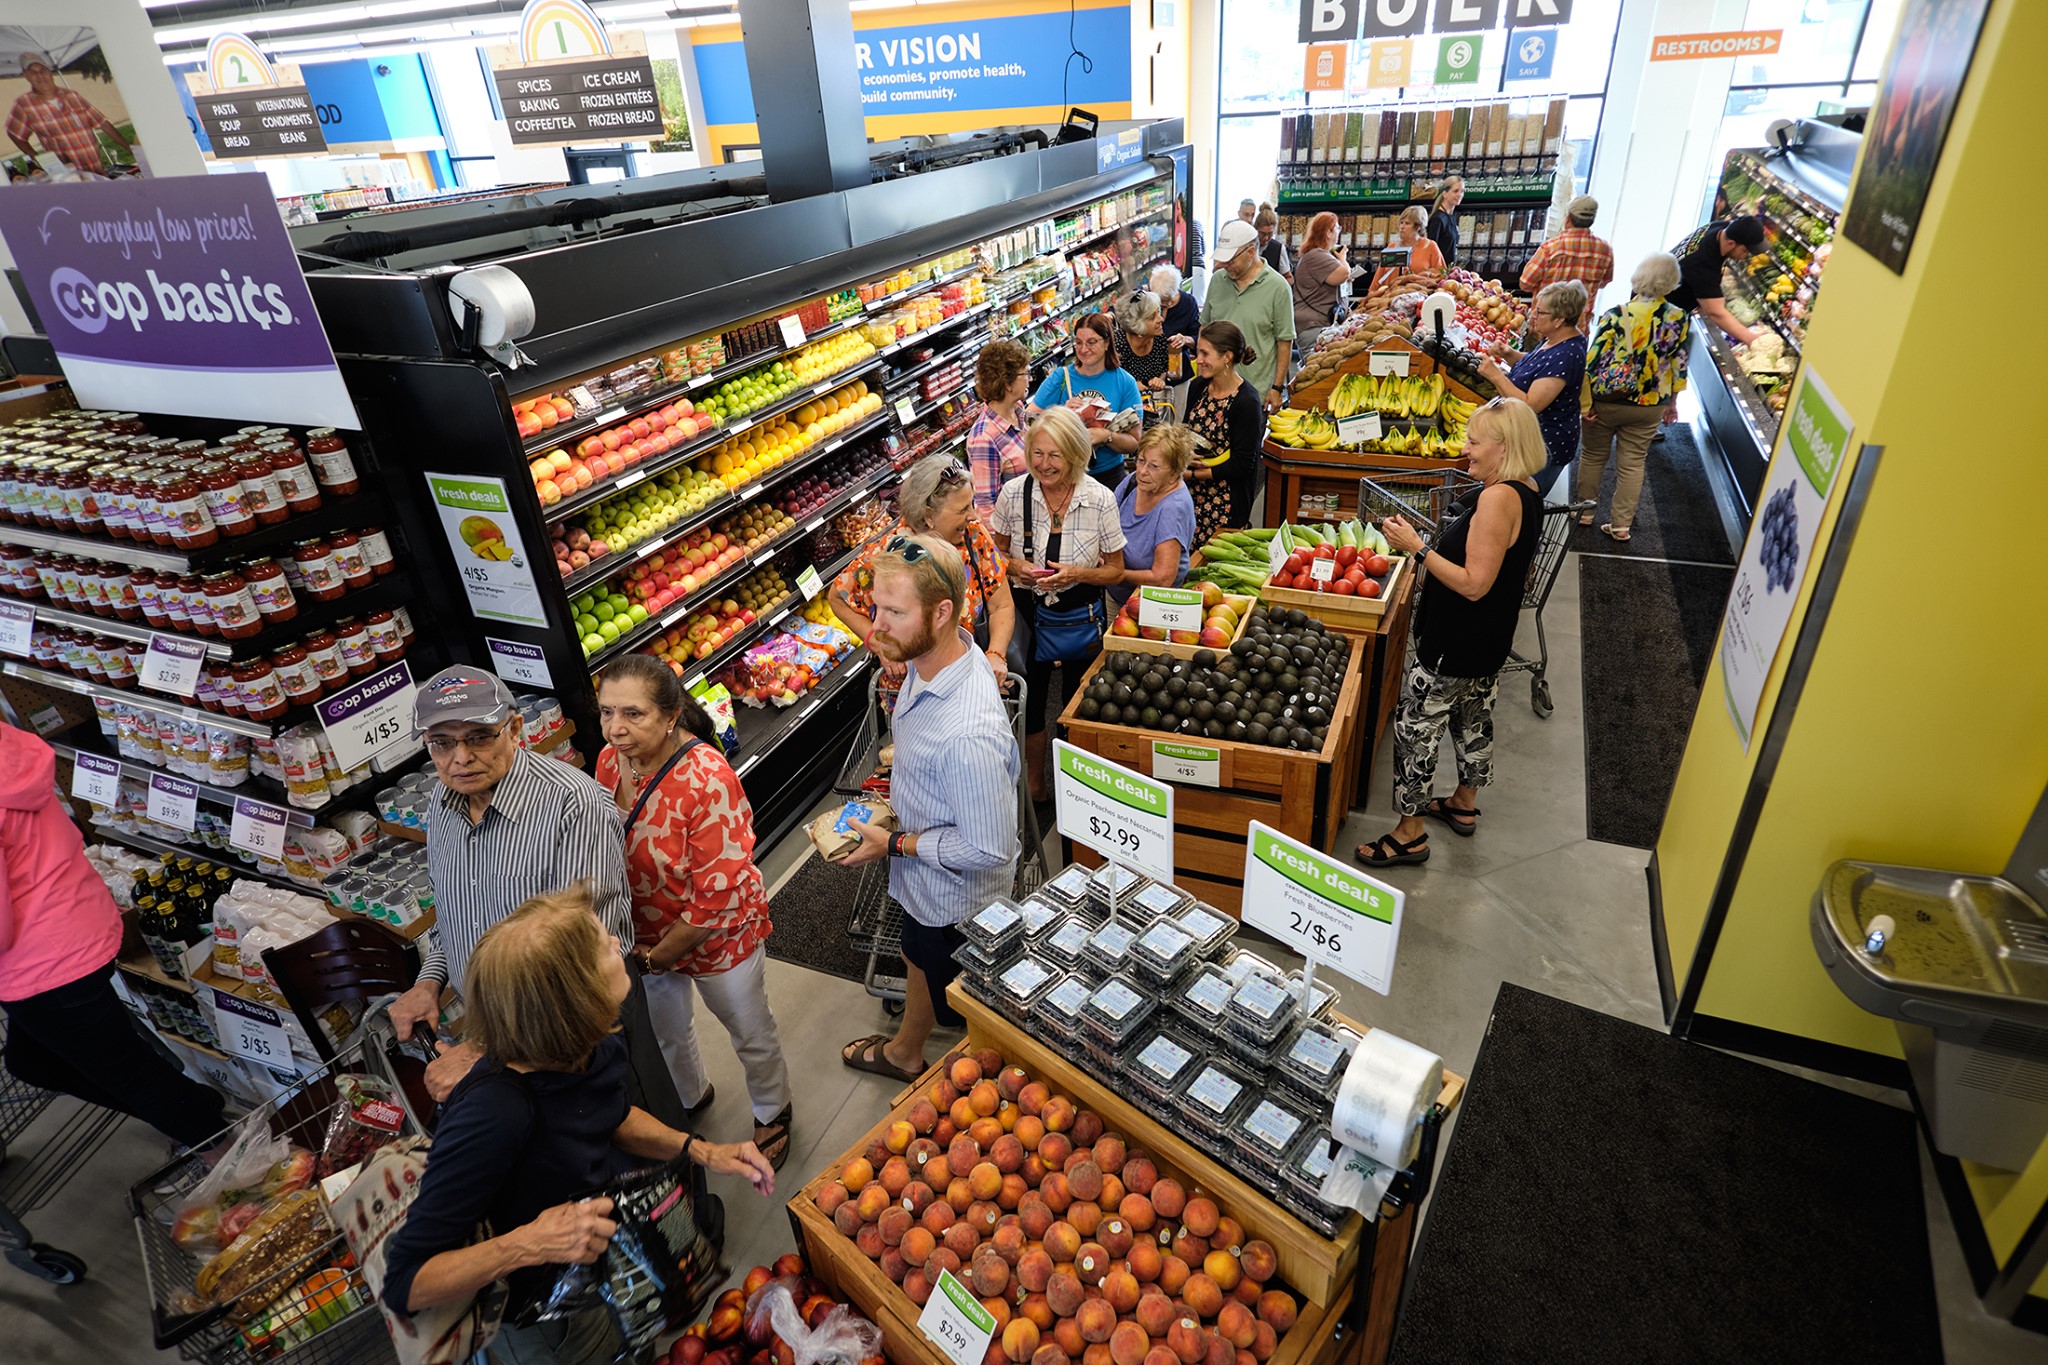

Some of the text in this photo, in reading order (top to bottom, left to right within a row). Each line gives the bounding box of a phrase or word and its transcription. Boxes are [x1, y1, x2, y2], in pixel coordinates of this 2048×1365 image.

[554, 21, 568, 54] 1
[878, 32, 982, 68] VISION
[1656, 37, 1761, 56] RESTROOMS
[230, 56, 249, 84] 2
[864, 62, 1026, 86] economies, promote health,
[1448, 71, 1464, 81] PAY
[1518, 67, 1539, 76] SAVE
[517, 79, 551, 93] SPICES
[583, 71, 641, 88] ICE CREAM
[1317, 79, 1331, 87] FILL
[581, 88, 653, 109] FROZEN ENTRÉES
[860, 86, 957, 103] build community.
[212, 103, 238, 116] PASTA
[256, 97, 308, 112] INTERNATIONAL
[519, 98, 560, 113] BAKING
[220, 119, 241, 132] SOUP
[262, 113, 313, 128] CONDIMENTS
[515, 117, 576, 132] COFFEE/TEA
[588, 109, 655, 128] FROZEN BREAD
[223, 136, 250, 148] BREAD
[279, 131, 307, 144] BEANS
[1497, 184, 1523, 192] reduce
[81, 203, 257, 260] everyday low prices!
[438, 486, 500, 503] fresh deals
[464, 566, 489, 581] 4/$5
[1151, 590, 1193, 601] fresh deals
[1162, 613, 1179, 622] 4/$5
[157, 670, 181, 684] $2.99
[514, 668, 533, 678] 4/$5
[364, 717, 400, 745] 4/$5
[1165, 745, 1208, 757] fresh deals
[1177, 767, 1195, 777] 4/$5
[1071, 757, 1157, 805] fresh deals
[88, 783, 102, 795] 3/$5
[161, 806, 180, 819] $9.99
[1065, 789, 1165, 841] Organic Peaches and Nectarines
[248, 832, 265, 846] 3/$5
[1089, 816, 1141, 852] $2.99
[1120, 848, 1132, 858] per
[1269, 843, 1380, 908] fresh deals
[1284, 891, 1353, 931] Fresh Blueberries
[1290, 911, 1342, 952] 2/$6
[240, 1034, 271, 1056] 3/$5
[947, 1281, 987, 1325] fresh deals
[939, 1319, 966, 1350] $2.99
